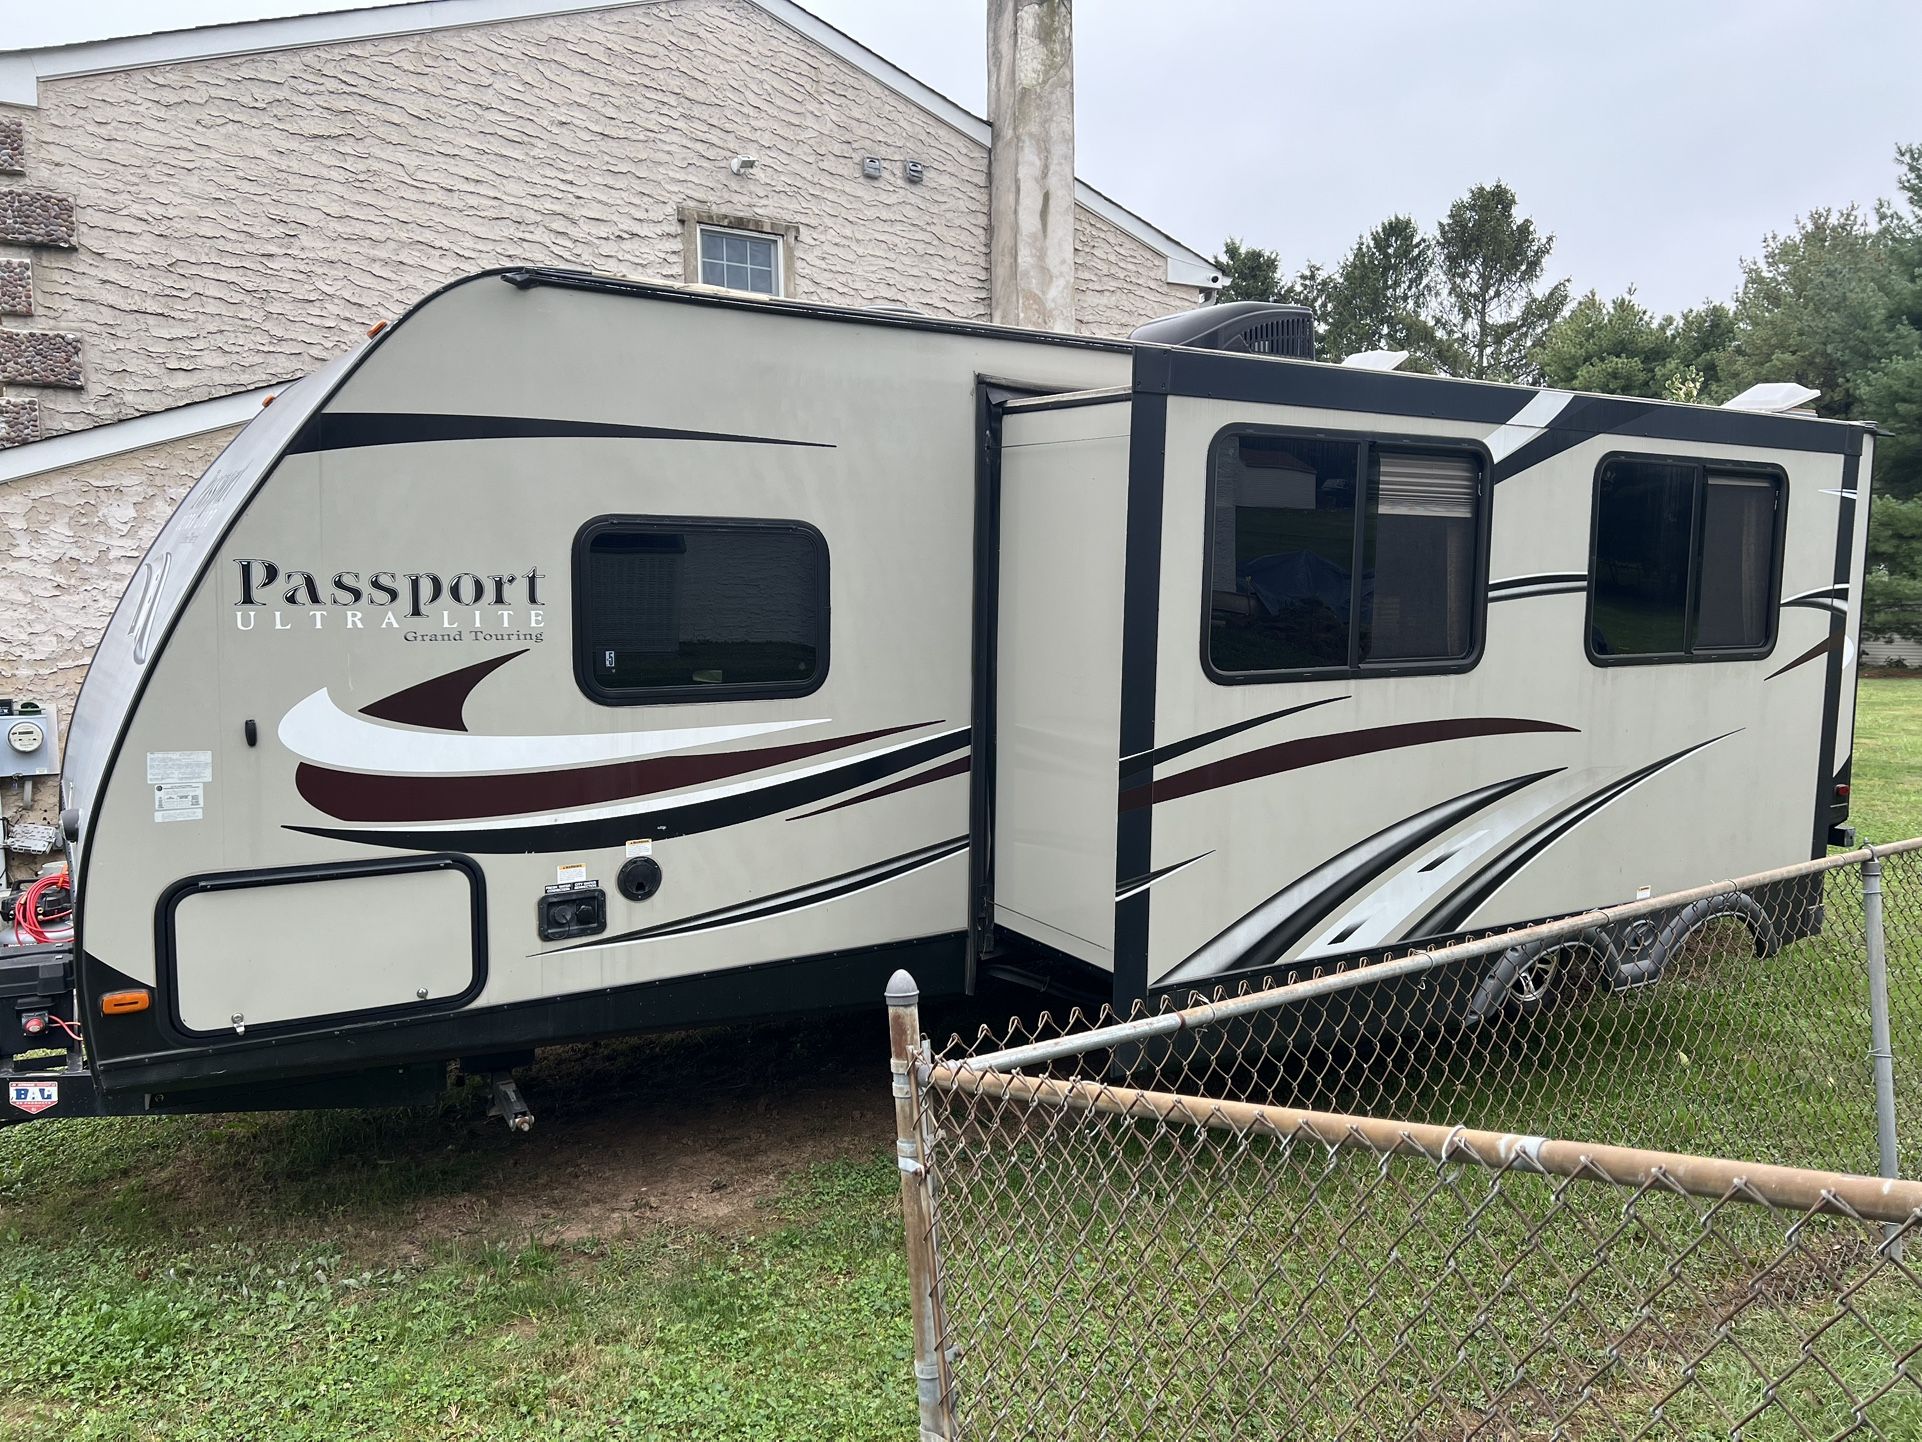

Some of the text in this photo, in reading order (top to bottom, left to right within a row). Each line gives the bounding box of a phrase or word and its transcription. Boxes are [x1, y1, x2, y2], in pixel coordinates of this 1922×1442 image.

[233, 558, 546, 618] Passport
[235, 610, 546, 631] ULTRA LITE
[403, 630, 544, 643] Grand Touring
